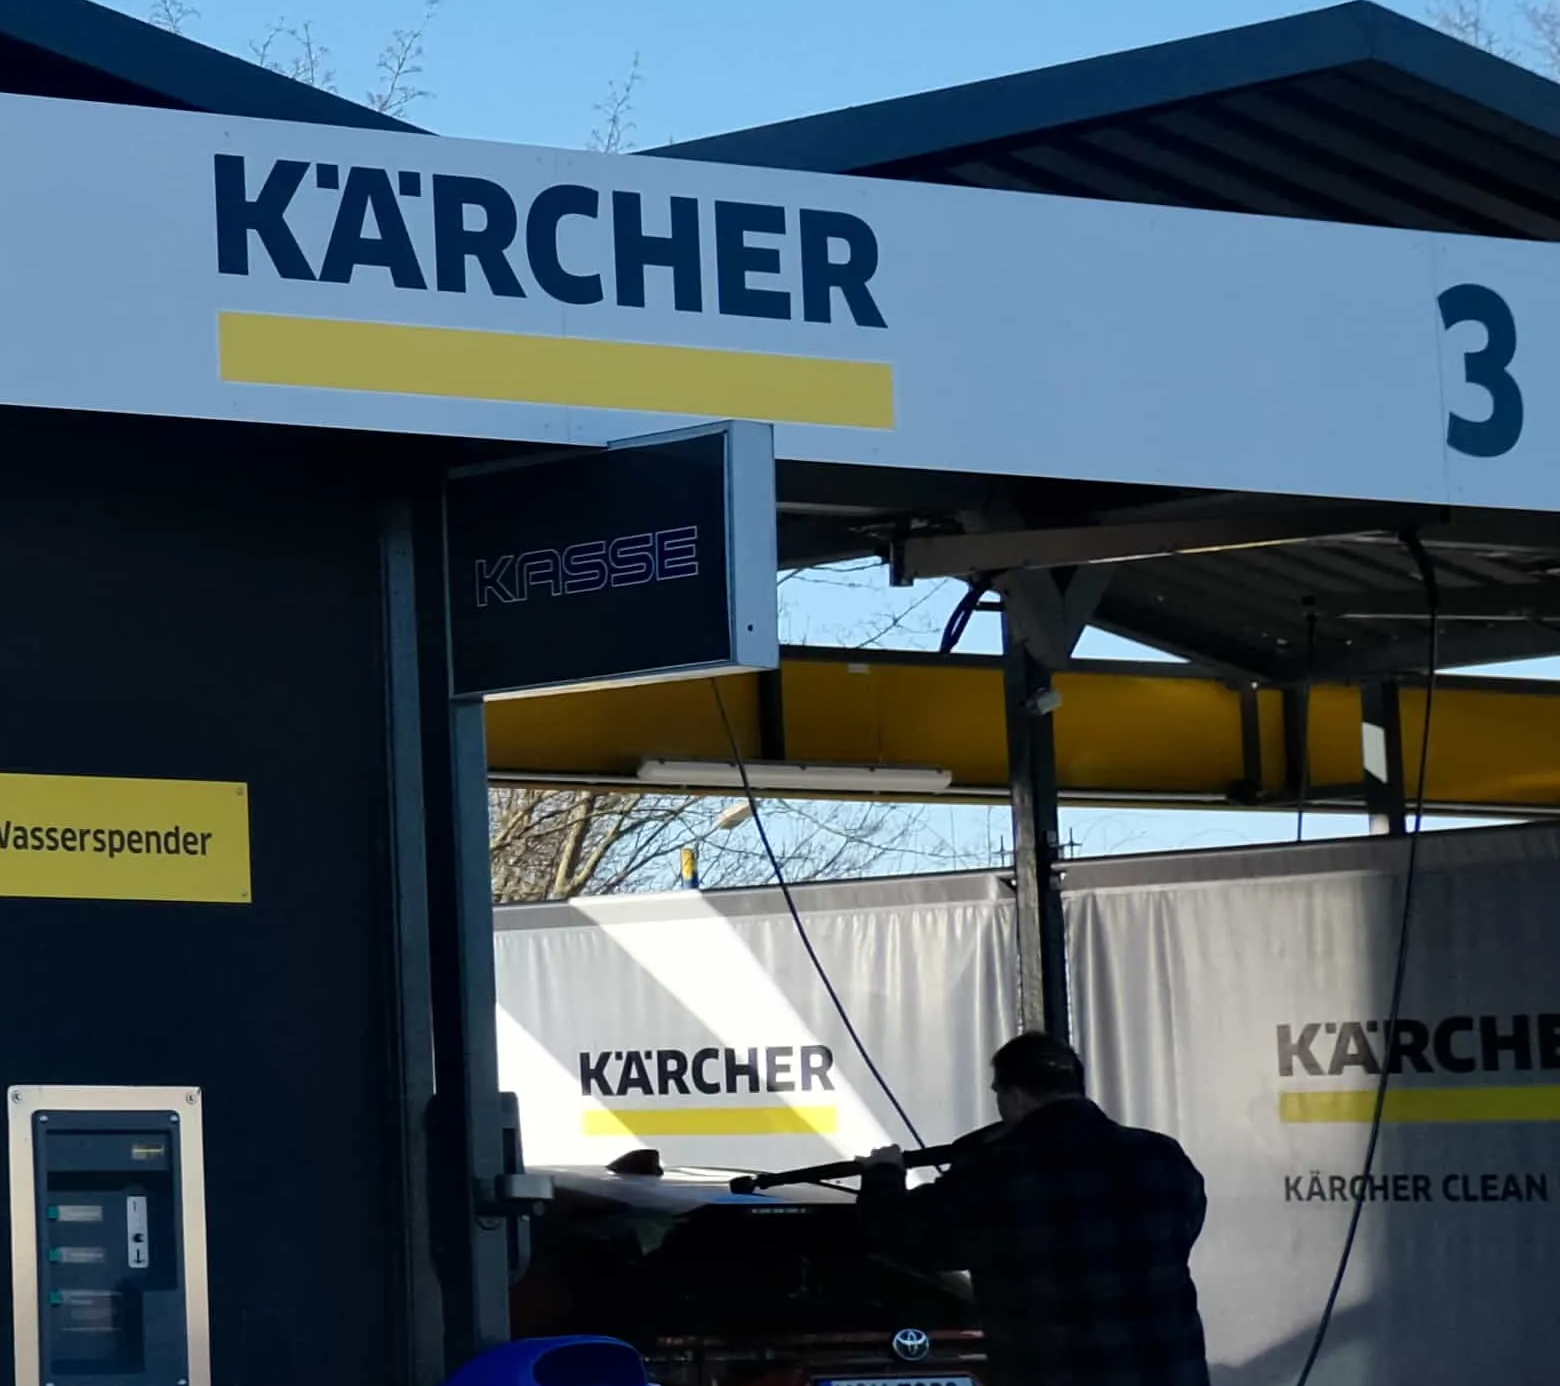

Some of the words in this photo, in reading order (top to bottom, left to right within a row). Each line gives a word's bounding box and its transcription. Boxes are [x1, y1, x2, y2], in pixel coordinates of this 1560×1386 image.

[214, 153, 889, 329] KÄRCHER
[1436, 283, 1524, 458] 3
[475, 525, 699, 608] KASSE
[579, 1045, 835, 1096] KÄRCHER
[1284, 1170, 1433, 1204] KÄRCHER
[1442, 1173, 1551, 1203] CLEAN
